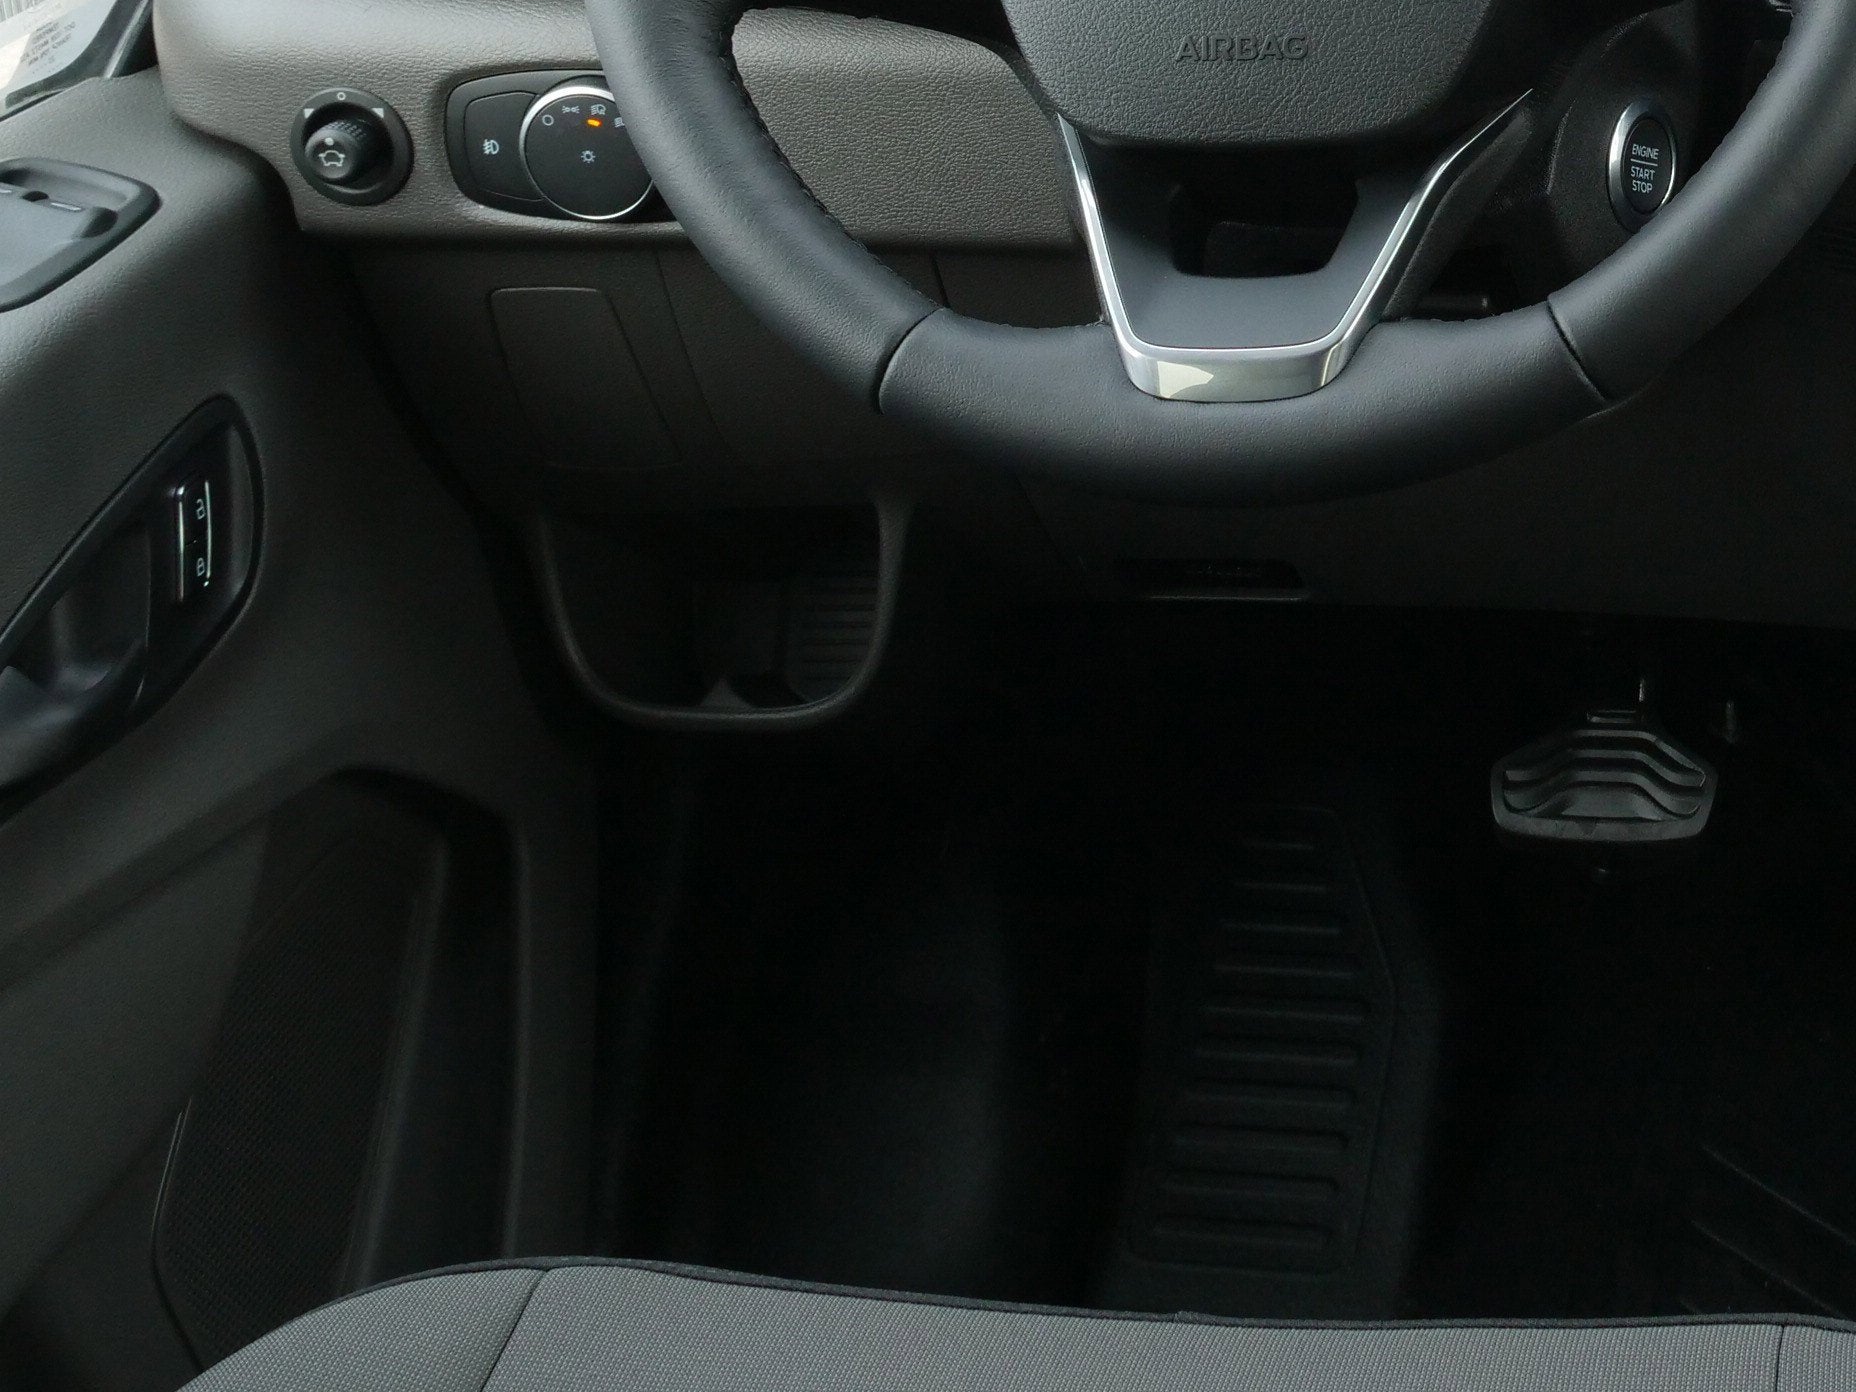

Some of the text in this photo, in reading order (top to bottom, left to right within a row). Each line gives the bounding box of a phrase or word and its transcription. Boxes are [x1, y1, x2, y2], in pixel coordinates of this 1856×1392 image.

[1172, 34, 1311, 64] AIRBAG
[1631, 143, 1660, 160] ENGINE
[1630, 165, 1656, 181] START
[1631, 180, 1653, 194] STOP
